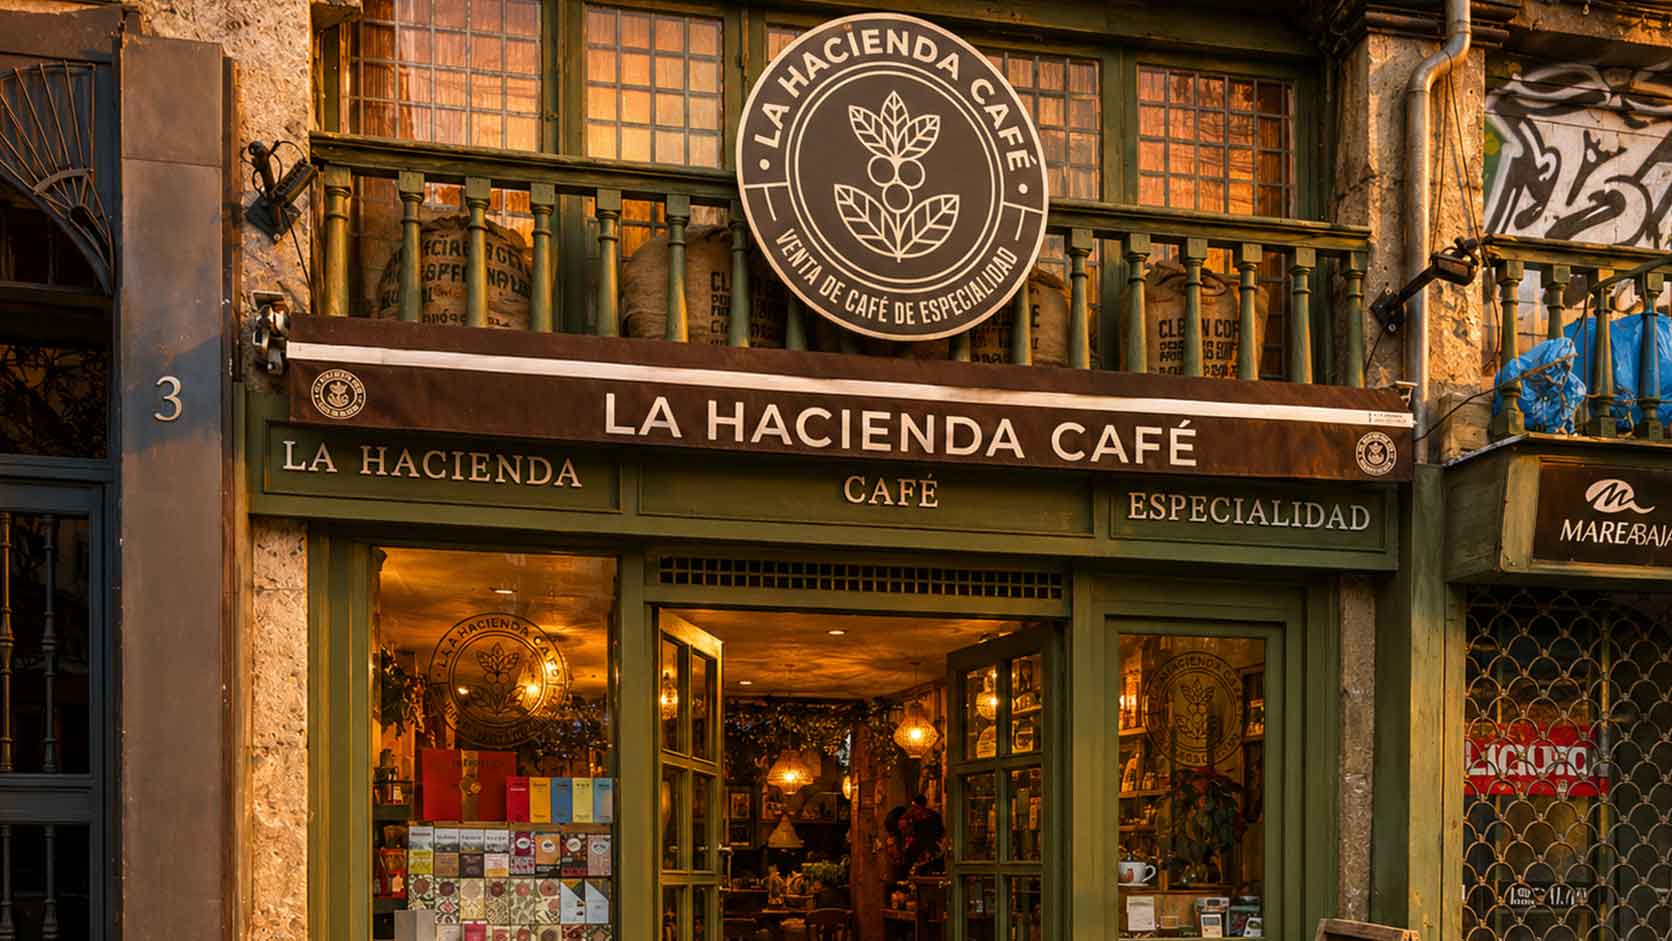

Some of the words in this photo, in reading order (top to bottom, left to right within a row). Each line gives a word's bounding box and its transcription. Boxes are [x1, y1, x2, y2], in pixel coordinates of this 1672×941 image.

[755, 103, 790, 149] LA
[778, 28, 959, 98] HACIENDA
[970, 78, 1038, 172] CAFÉ
[775, 228, 823, 286] VENTA
[818, 275, 846, 304] DE
[845, 289, 889, 323] CAFÉ
[894, 301, 916, 325] DE
[919, 246, 1019, 324] ESPECIALIDAD
[154, 375, 183, 421] 3
[605, 392, 683, 438] LA
[706, 398, 1025, 458] HACIENDA
[1051, 418, 1197, 467] CAFÉ
[282, 440, 338, 473] LA
[359, 445, 583, 488] HACIENDA
[843, 474, 939, 509] CAFÉ
[1127, 491, 1371, 531] ESPECIALIDAD
[458, 617, 530, 639] HACIENDA
